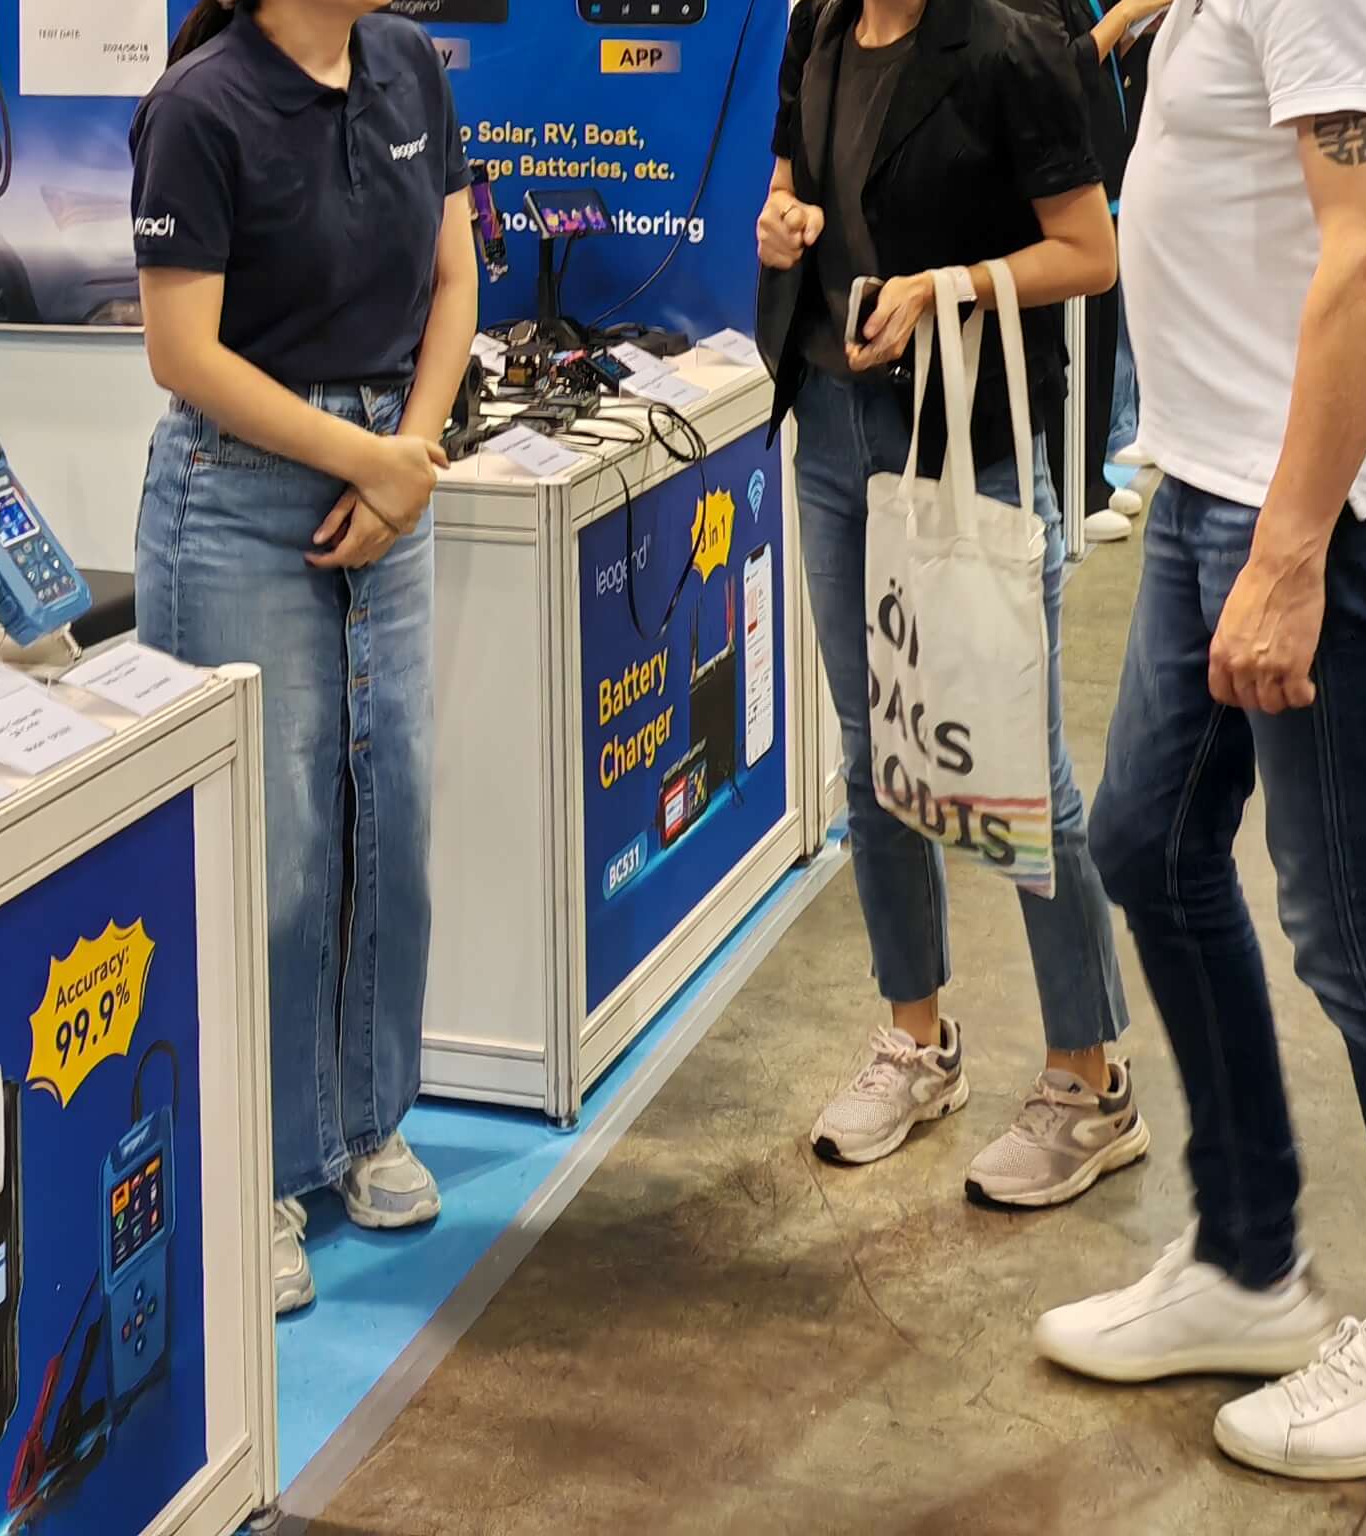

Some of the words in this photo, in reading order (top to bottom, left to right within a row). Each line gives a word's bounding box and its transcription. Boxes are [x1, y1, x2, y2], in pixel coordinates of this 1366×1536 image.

[619, 46, 663, 68] APP
[478, 121, 538, 148] Solar,
[544, 122, 578, 149] RV,
[585, 123, 645, 151] Boat,
[520, 154, 628, 183] Batteries,
[634, 158, 675, 181] etc.
[612, 209, 705, 244] itoring
[708, 522, 719, 550] in
[598, 646, 669, 728] Battery
[599, 703, 674, 791] Charger
[872, 743, 1016, 868] ODIS
[608, 843, 642, 891] BC531
[54, 947, 131, 1012] Accuracy:
[54, 978, 132, 1068] 99.9%
